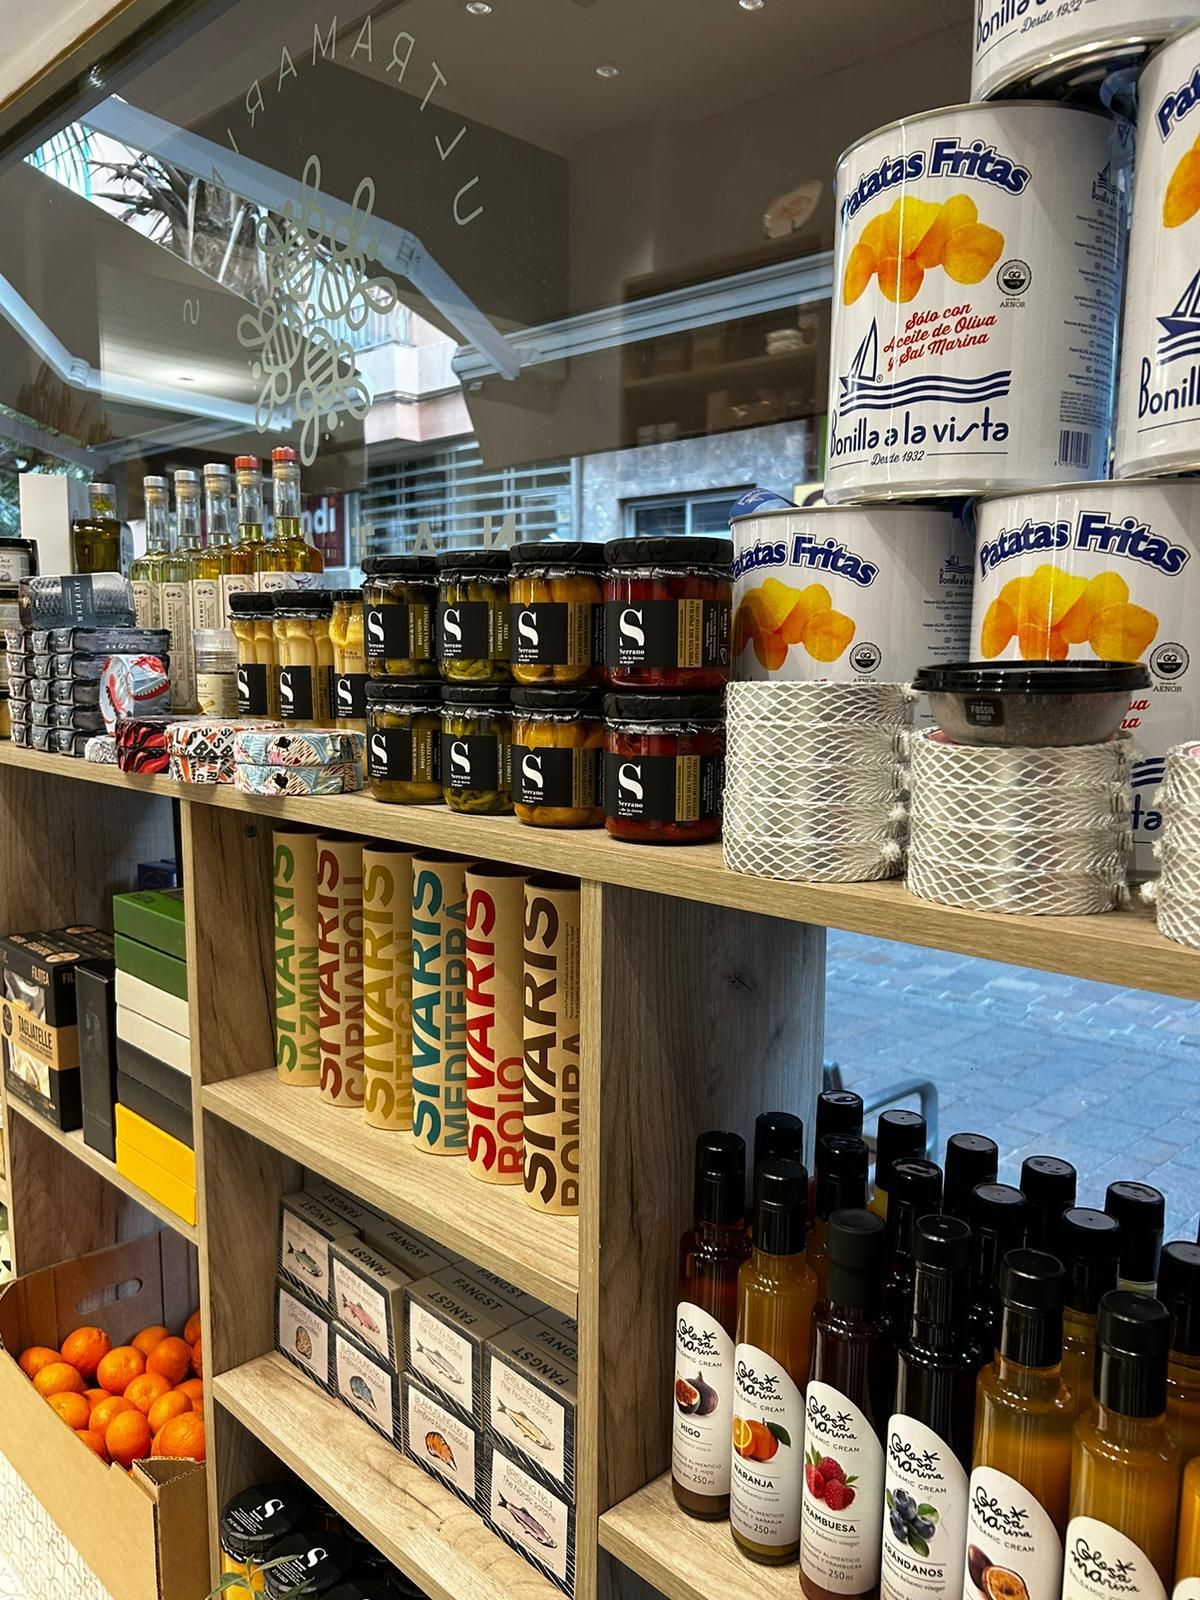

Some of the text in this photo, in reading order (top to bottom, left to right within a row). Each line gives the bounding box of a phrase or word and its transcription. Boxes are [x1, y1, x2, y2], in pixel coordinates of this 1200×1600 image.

[1020, 9, 1054, 34] Desde
[841, 138, 1032, 226] Patatas Fritas
[905, 303, 973, 333] Sólo con
[1000, 301, 1026, 309] AENOR
[883, 313, 998, 353] Aceite de Oliva
[898, 345, 925, 368] Sal
[927, 331, 991, 356] Marina
[1138, 356, 1200, 419] Bonill
[830, 406, 1010, 460] Bonilla a la vista
[870, 450, 926, 467] Desde 1932
[790, 533, 880, 588] Fritas
[979, 510, 1191, 582] Patatas Fritas
[368, 611, 385, 641] S
[444, 609, 462, 641] S
[518, 611, 539, 646] S
[619, 609, 645, 647] S
[518, 647, 539, 655] Serrano
[1163, 654, 1177, 662] GQ
[280, 671, 294, 703] S
[338, 678, 353, 705] S
[1152, 685, 1183, 693] AENOR
[970, 704, 996, 715] FOSSIL
[371, 733, 388, 764] S
[451, 741, 471, 773] S
[451, 773, 471, 781] Serrano
[522, 753, 544, 789] S
[618, 763, 643, 800] S
[522, 788, 544, 797] Serrano
[618, 800, 644, 809] Serrano
[274, 844, 298, 1073] SIVARIS
[316, 849, 343, 1099] SIVARIS
[31, 964, 50, 987] FILOTEA
[363, 864, 395, 1120] SIVARIS
[412, 869, 443, 1147] SIVARIS
[17, 1015, 53, 1050] TAGLIATELLE
[465, 888, 497, 1171] SIVARIS
[523, 896, 559, 1205] SIVARIS
[300, 1200, 338, 1227] FANGST
[322, 1193, 362, 1220] FANGST
[386, 1230, 431, 1260] FANGST
[348, 1246, 391, 1278] FANGST
[452, 1278, 504, 1311] FANGST
[476, 1267, 528, 1298] FANGST
[427, 1291, 479, 1325] FANGST
[536, 1330, 578, 1362] FANGS
[512, 1346, 570, 1386] FANGST
[698, 1358, 723, 1368] CREAM
[500, 1379, 511, 1394] The
[511, 1388, 531, 1408] Nordic
[760, 1404, 786, 1413] CREAM
[680, 1422, 701, 1439] HIGO
[832, 1443, 860, 1454] CREAM
[506, 1464, 537, 1496] BRISLING
[692, 1474, 708, 1485] 250
[734, 1463, 774, 1489] NARANJA
[918, 1484, 947, 1495] CREAM
[503, 1474, 556, 1524] The Nordic sardine
[753, 1523, 769, 1535] 250
[803, 1500, 856, 1533] FRAMBUESA
[884, 1541, 944, 1579] ARÁNDANOS
[1004, 1541, 1035, 1553] CREAM
[828, 1568, 854, 1582] 250 ml
